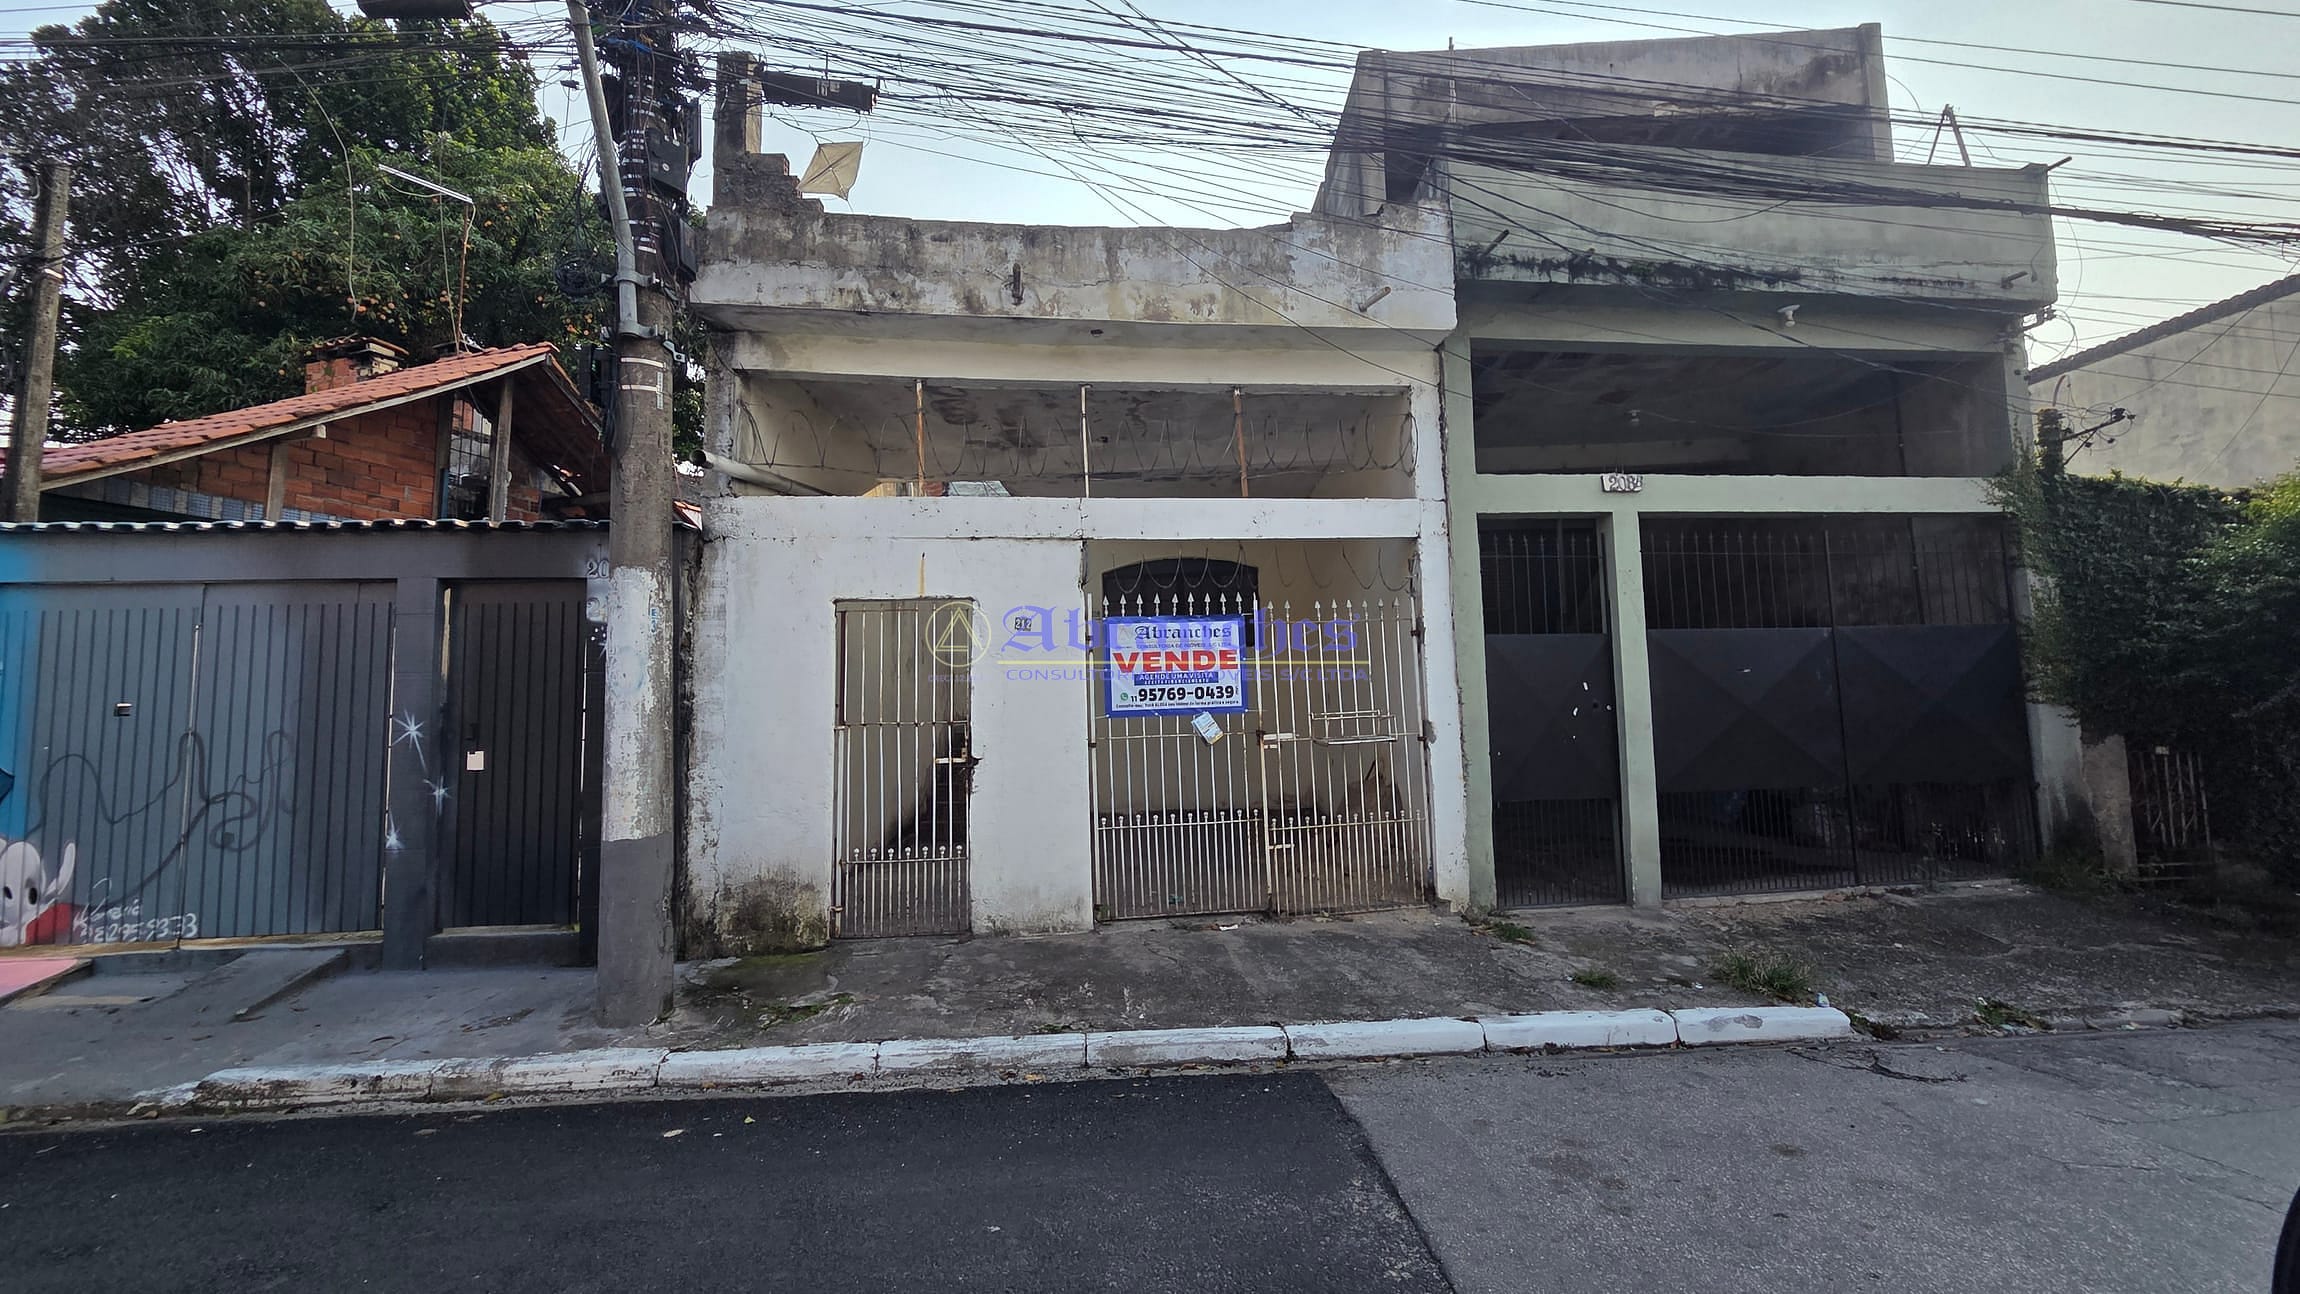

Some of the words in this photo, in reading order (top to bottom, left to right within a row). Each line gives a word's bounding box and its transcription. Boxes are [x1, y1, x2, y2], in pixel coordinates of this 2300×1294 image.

[1015, 617, 1031, 630] 212
[1135, 624, 1232, 640] Abranches
[1112, 650, 1239, 674] VENDE
[1171, 672, 1188, 680] UMA
[1189, 671, 1213, 679] VISITA
[1138, 685, 1235, 702] 95769-0439
